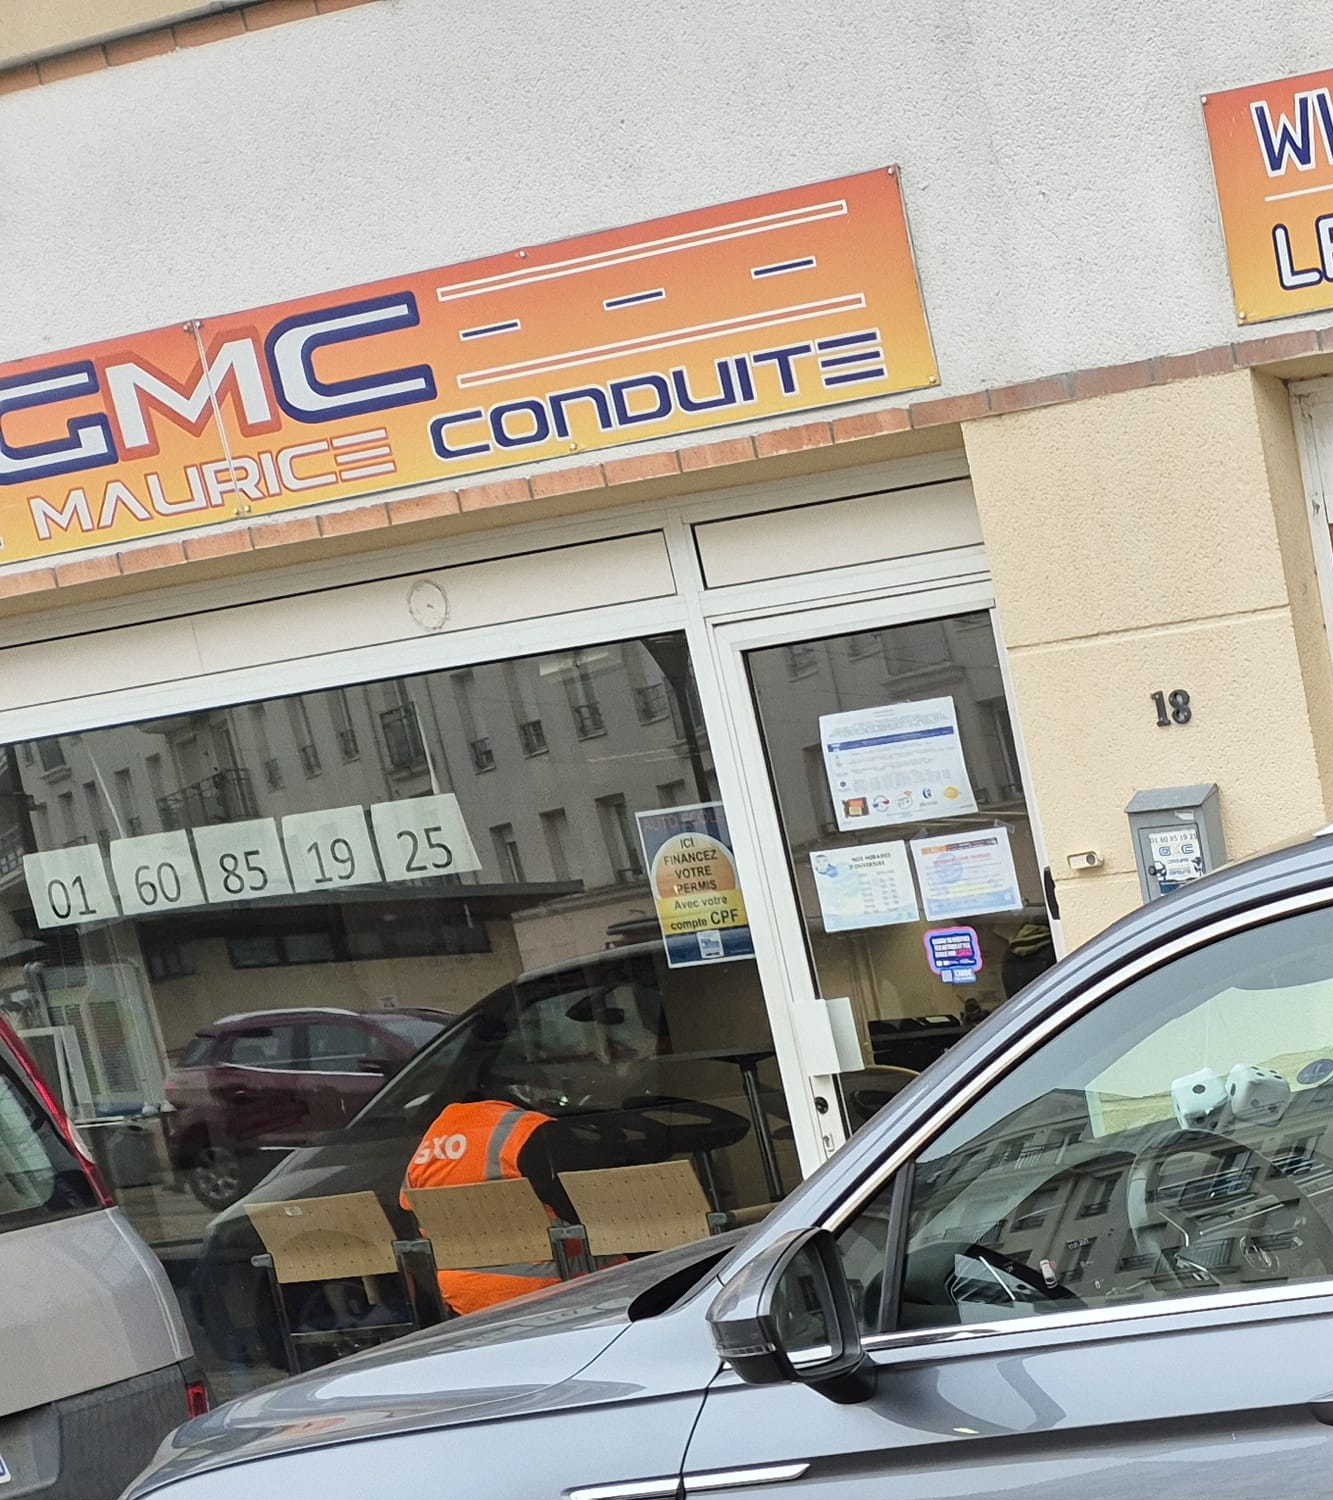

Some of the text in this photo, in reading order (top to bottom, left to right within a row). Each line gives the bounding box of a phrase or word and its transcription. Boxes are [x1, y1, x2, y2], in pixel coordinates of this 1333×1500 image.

[0, 290, 438, 486] GMC
[27, 328, 888, 540] MAURICE CONDUITE
[1149, 688, 1193, 727] 18
[680, 836, 695, 849] ICI
[663, 849, 719, 866] FINANCEZ
[47, 826, 455, 920] 01 60 85 19 25
[674, 865, 712, 879] VOTRE
[677, 880, 718, 895] PERMIS
[674, 895, 728, 910] Avec votre
[670, 908, 740, 932] compte CPF
